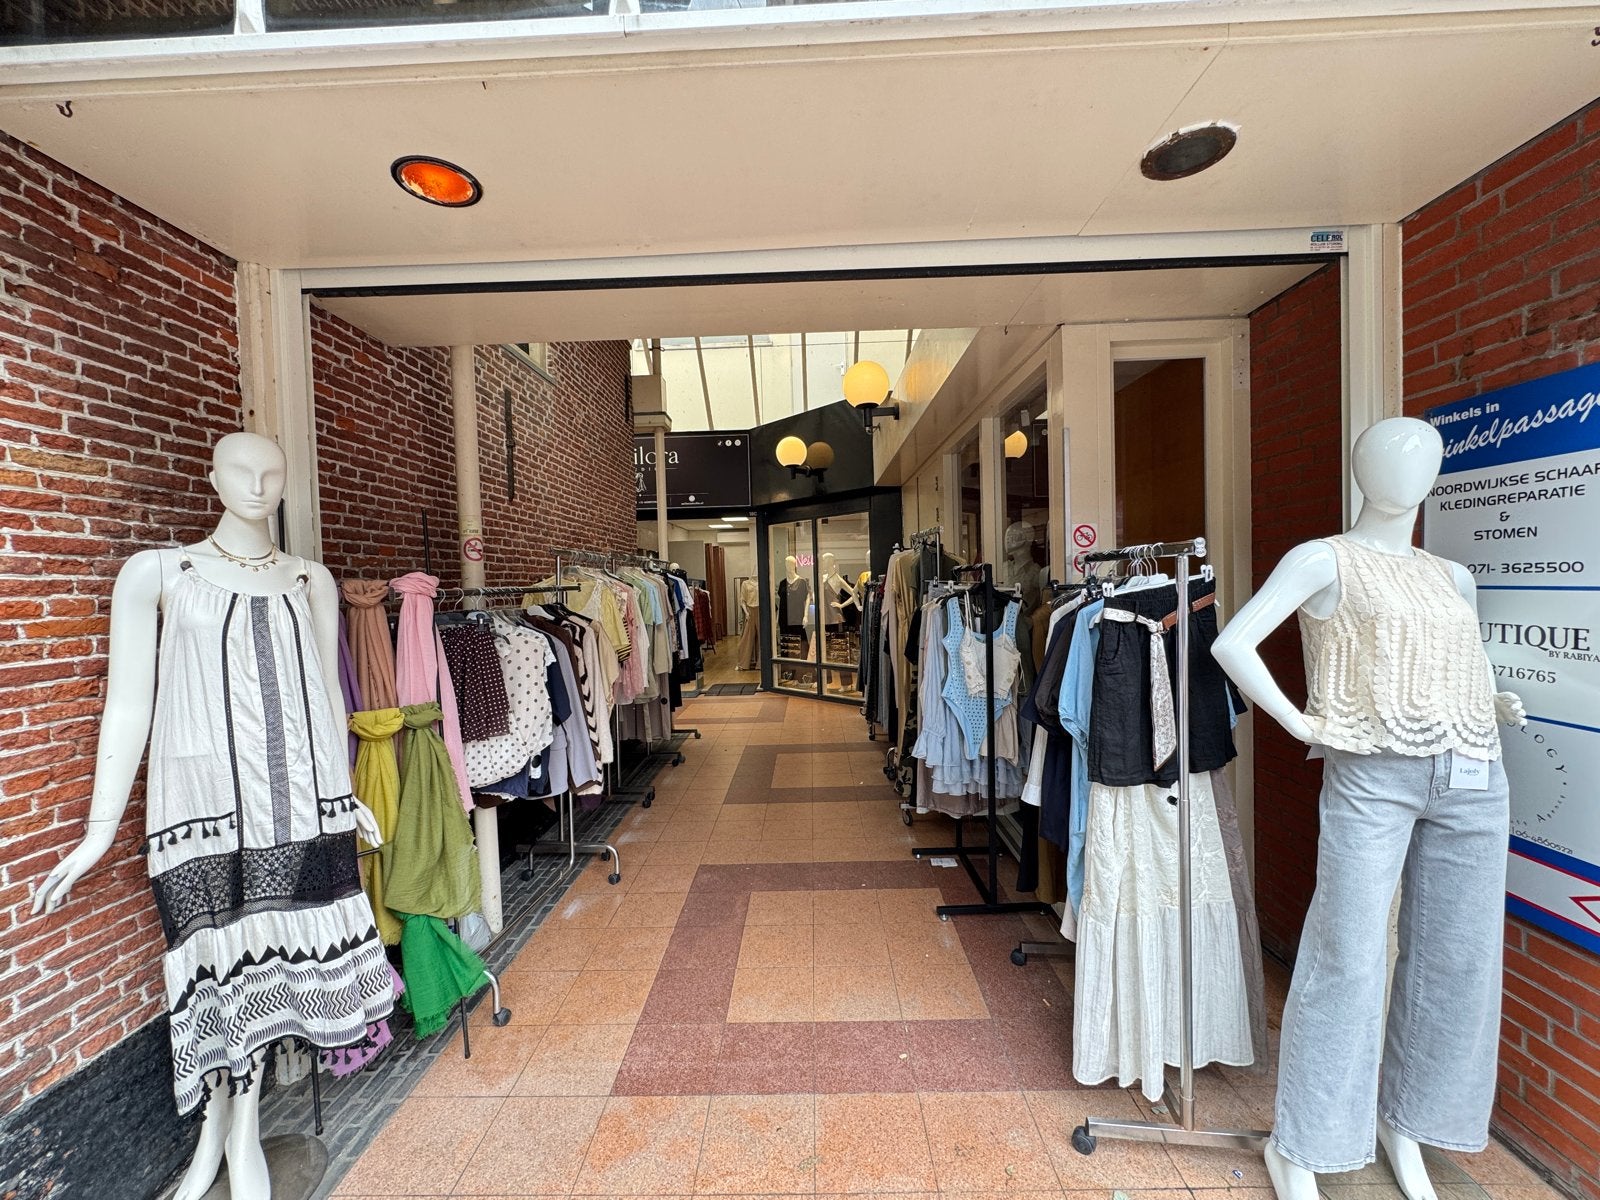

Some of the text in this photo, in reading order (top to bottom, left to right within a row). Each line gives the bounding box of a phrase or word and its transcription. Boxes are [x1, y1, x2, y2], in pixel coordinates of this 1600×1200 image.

[1430, 402, 1500, 427] Winkels in
[1442, 391, 1600, 459] inkelpassag
[1427, 473, 1530, 498] NOORDWIJKSE
[1440, 484, 1586, 511] KLEDINGREPARATIE
[1499, 511, 1511, 522] &
[1473, 526, 1538, 541] STOMEN
[1500, 561, 1585, 574] 3625500
[1548, 650, 1600, 663] BY RABIYA
